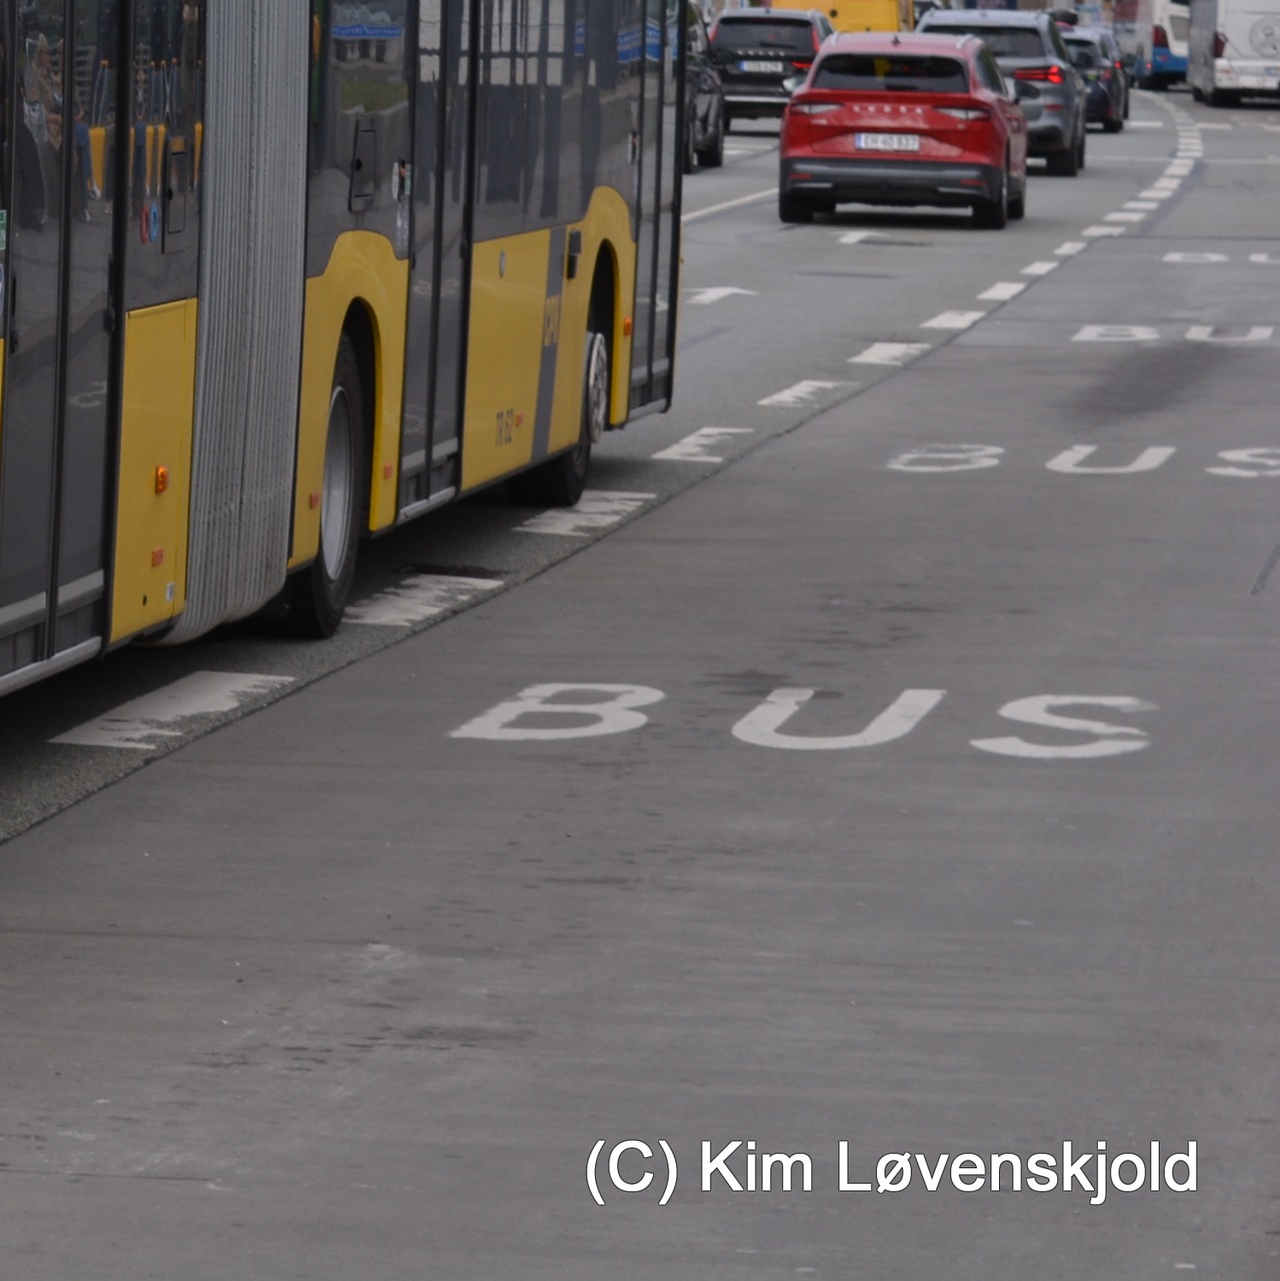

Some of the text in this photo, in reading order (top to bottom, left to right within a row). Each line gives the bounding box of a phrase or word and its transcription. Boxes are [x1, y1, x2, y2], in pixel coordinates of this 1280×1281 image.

[1071, 325, 1274, 342] BU
[886, 443, 1280, 477] BUS
[449, 683, 1160, 759] BUS
